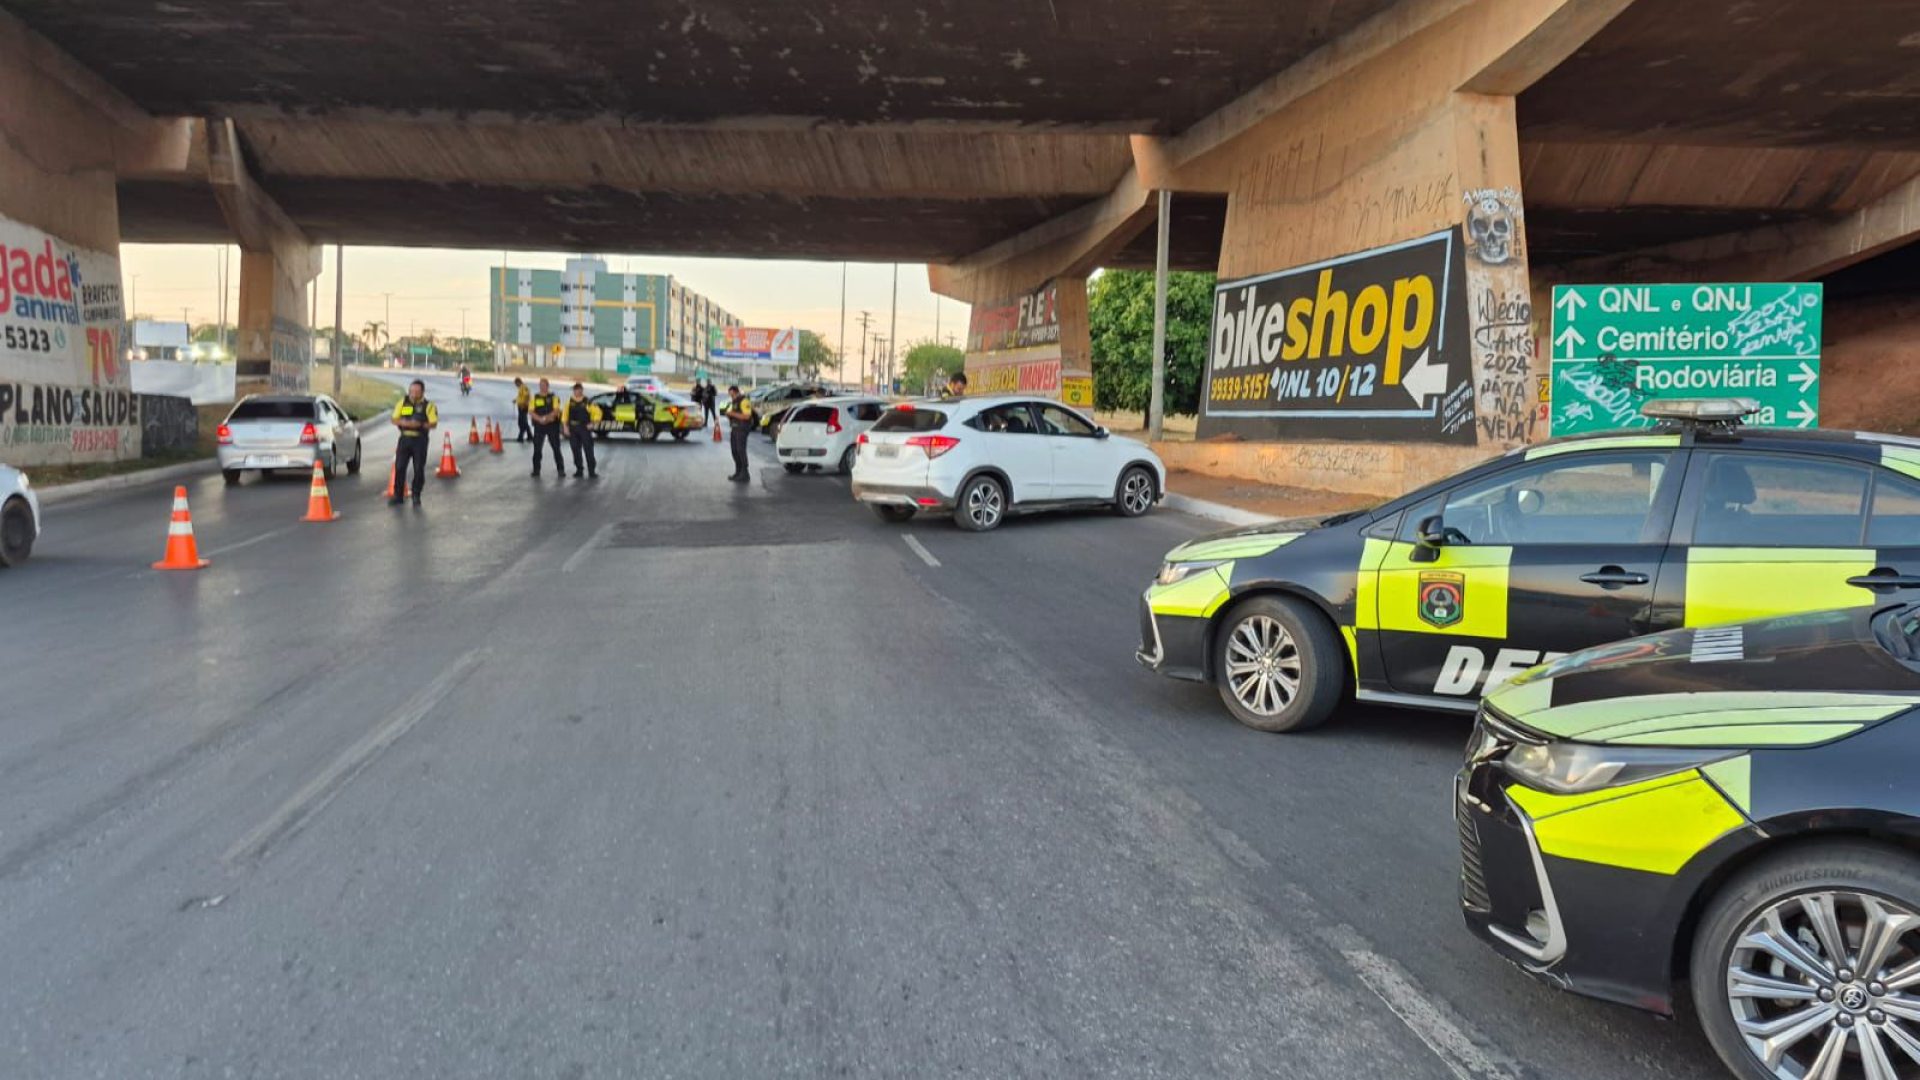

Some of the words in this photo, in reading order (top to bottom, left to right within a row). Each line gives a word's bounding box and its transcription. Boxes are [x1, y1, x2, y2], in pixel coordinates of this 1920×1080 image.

[15, 295, 80, 325] animal
[1600, 287, 1660, 312] QNL
[1671, 299, 1681, 311] e
[1692, 286, 1752, 312] QNJ
[1596, 325, 1729, 352] Cemitério
[1483, 353, 1532, 376] 2024
[1635, 363, 1777, 389] Rodoviária
[1316, 364, 1378, 404] 10/12
[0, 383, 75, 426] PLANO
